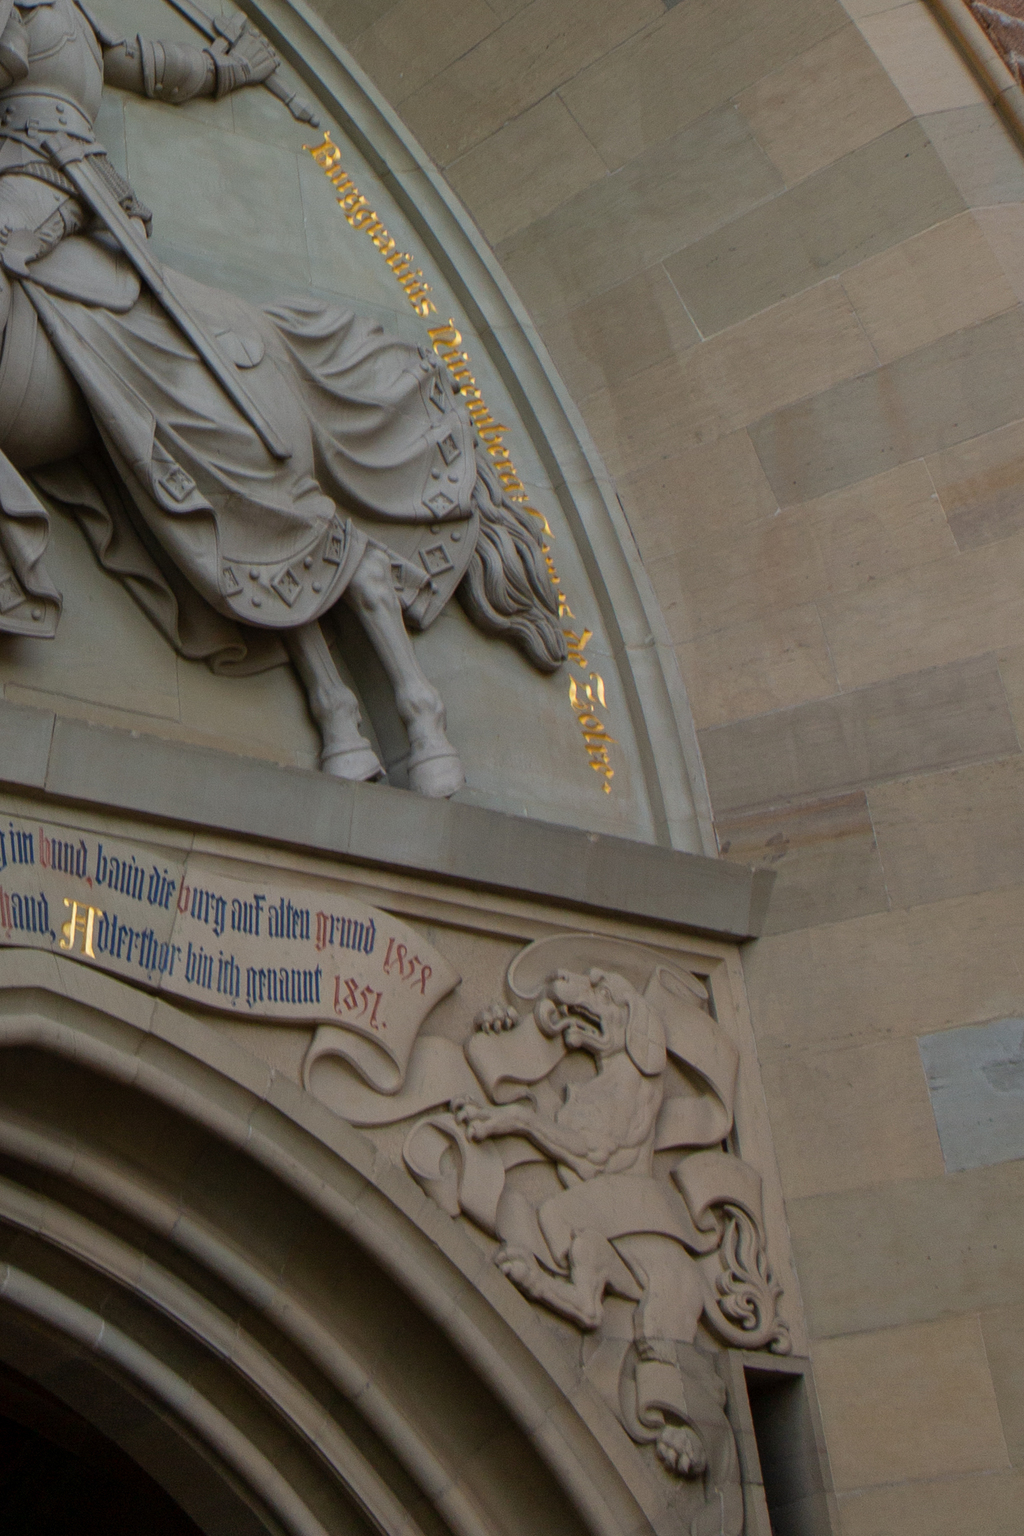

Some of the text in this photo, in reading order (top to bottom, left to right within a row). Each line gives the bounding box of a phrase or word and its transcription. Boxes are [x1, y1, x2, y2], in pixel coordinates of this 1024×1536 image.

[9, 821, 35, 865] im
[146, 865, 176, 910] die
[230, 894, 266, 937] auf
[268, 896, 311, 941] alten
[59, 897, 182, 981] Adlerthor
[184, 941, 214, 990] bin
[217, 950, 241, 1007] ich
[245, 963, 323, 1009] genannt
